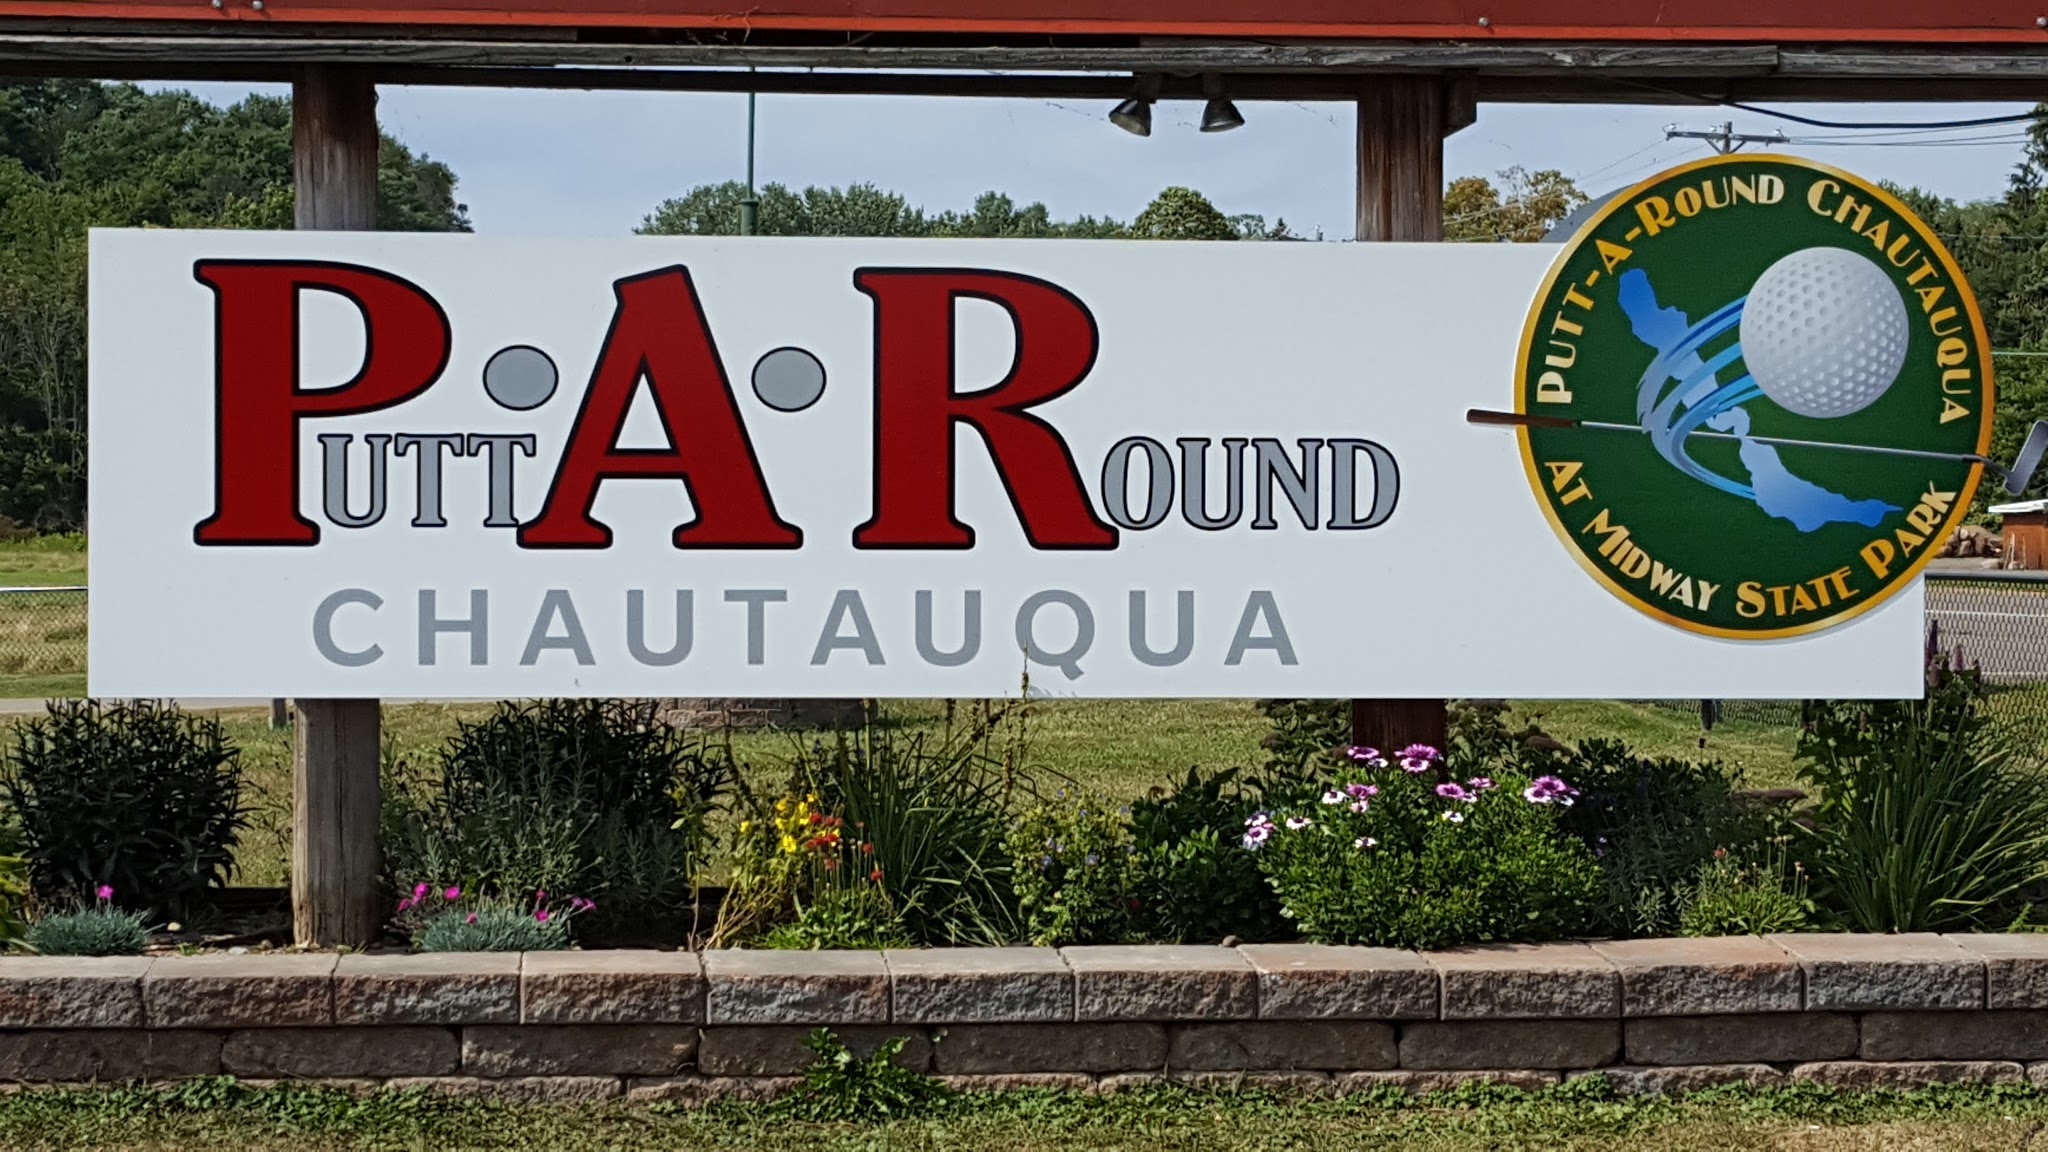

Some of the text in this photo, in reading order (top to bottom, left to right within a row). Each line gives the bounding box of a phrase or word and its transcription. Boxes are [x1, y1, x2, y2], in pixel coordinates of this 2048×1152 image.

[1807, 179, 1972, 425] CHAUTAUQUA
[516, 264, 803, 550] A
[312, 588, 1299, 681] CHAUTAUQUA
[1543, 461, 1957, 618] AT MIDWAY STATE PARK
